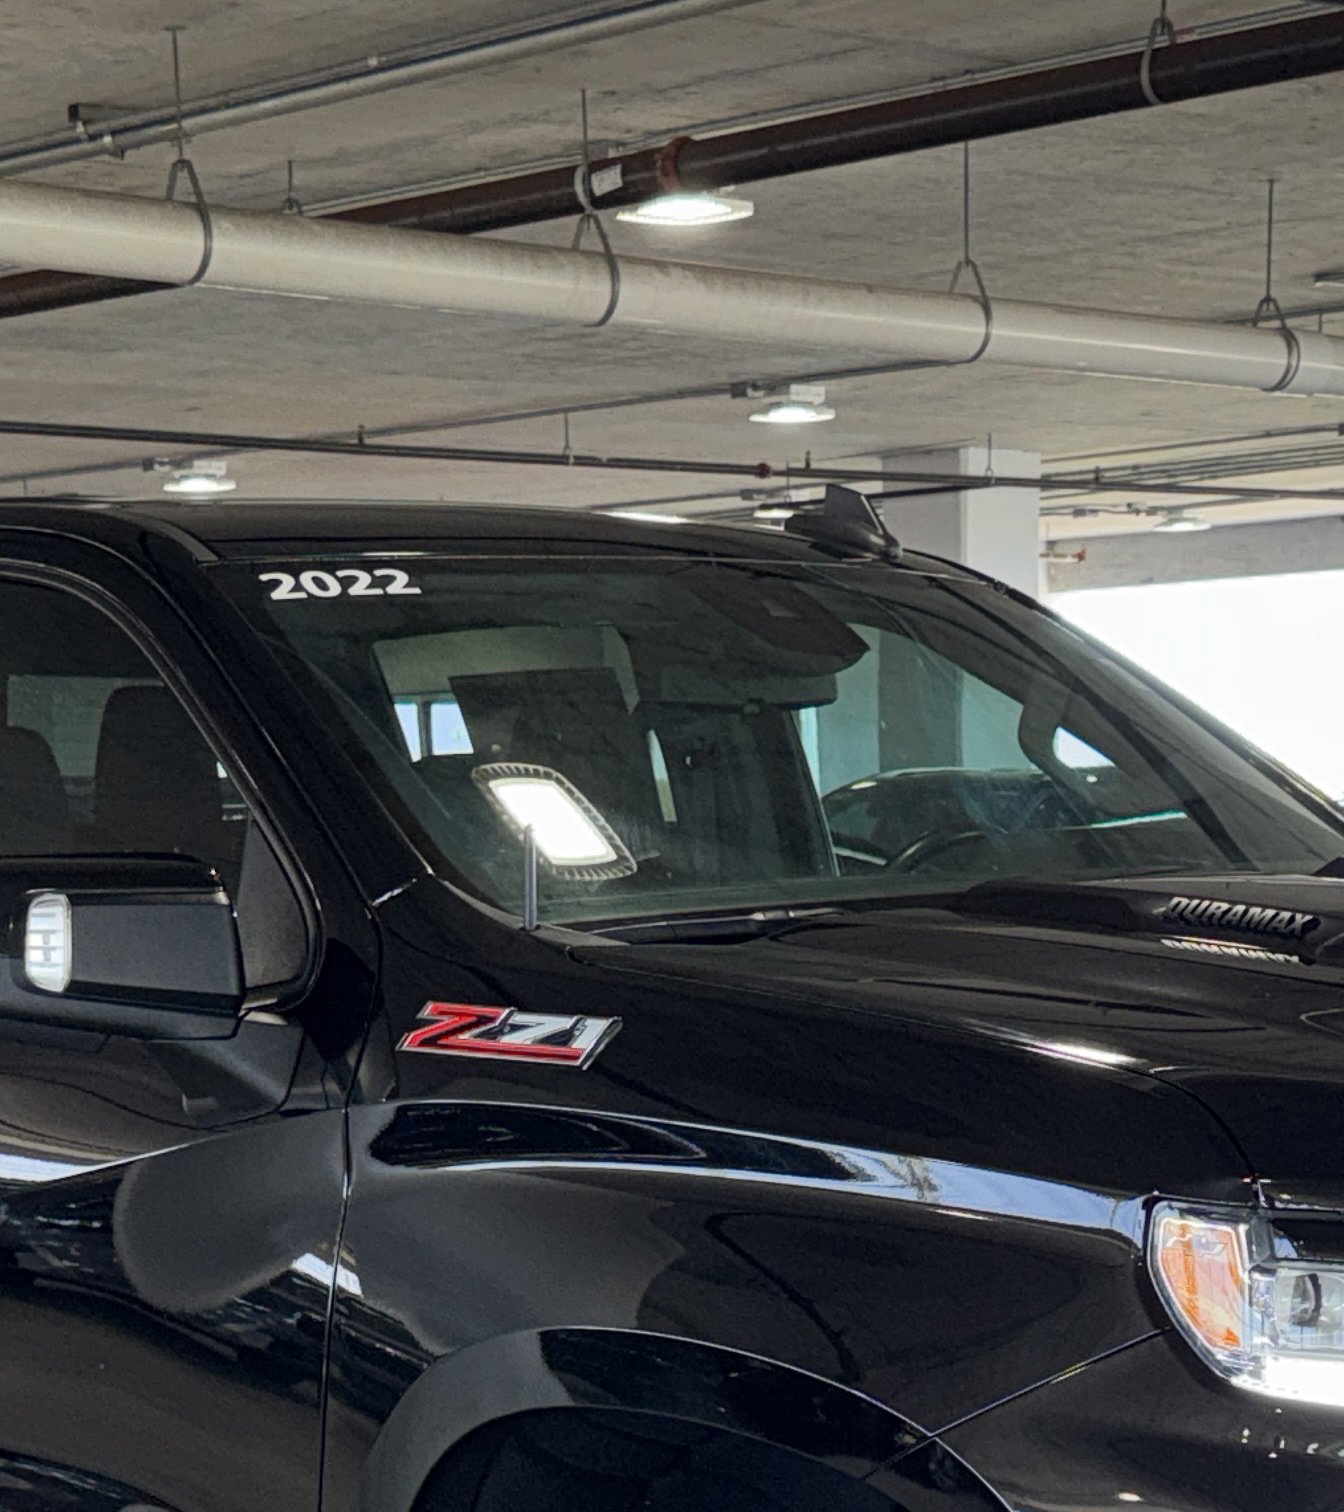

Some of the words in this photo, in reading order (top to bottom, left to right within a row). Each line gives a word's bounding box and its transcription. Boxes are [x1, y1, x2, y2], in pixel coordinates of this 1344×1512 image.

[258, 568, 423, 601] 2022
[1164, 896, 1316, 938] DURAMAX
[395, 1000, 624, 1070] Z71
